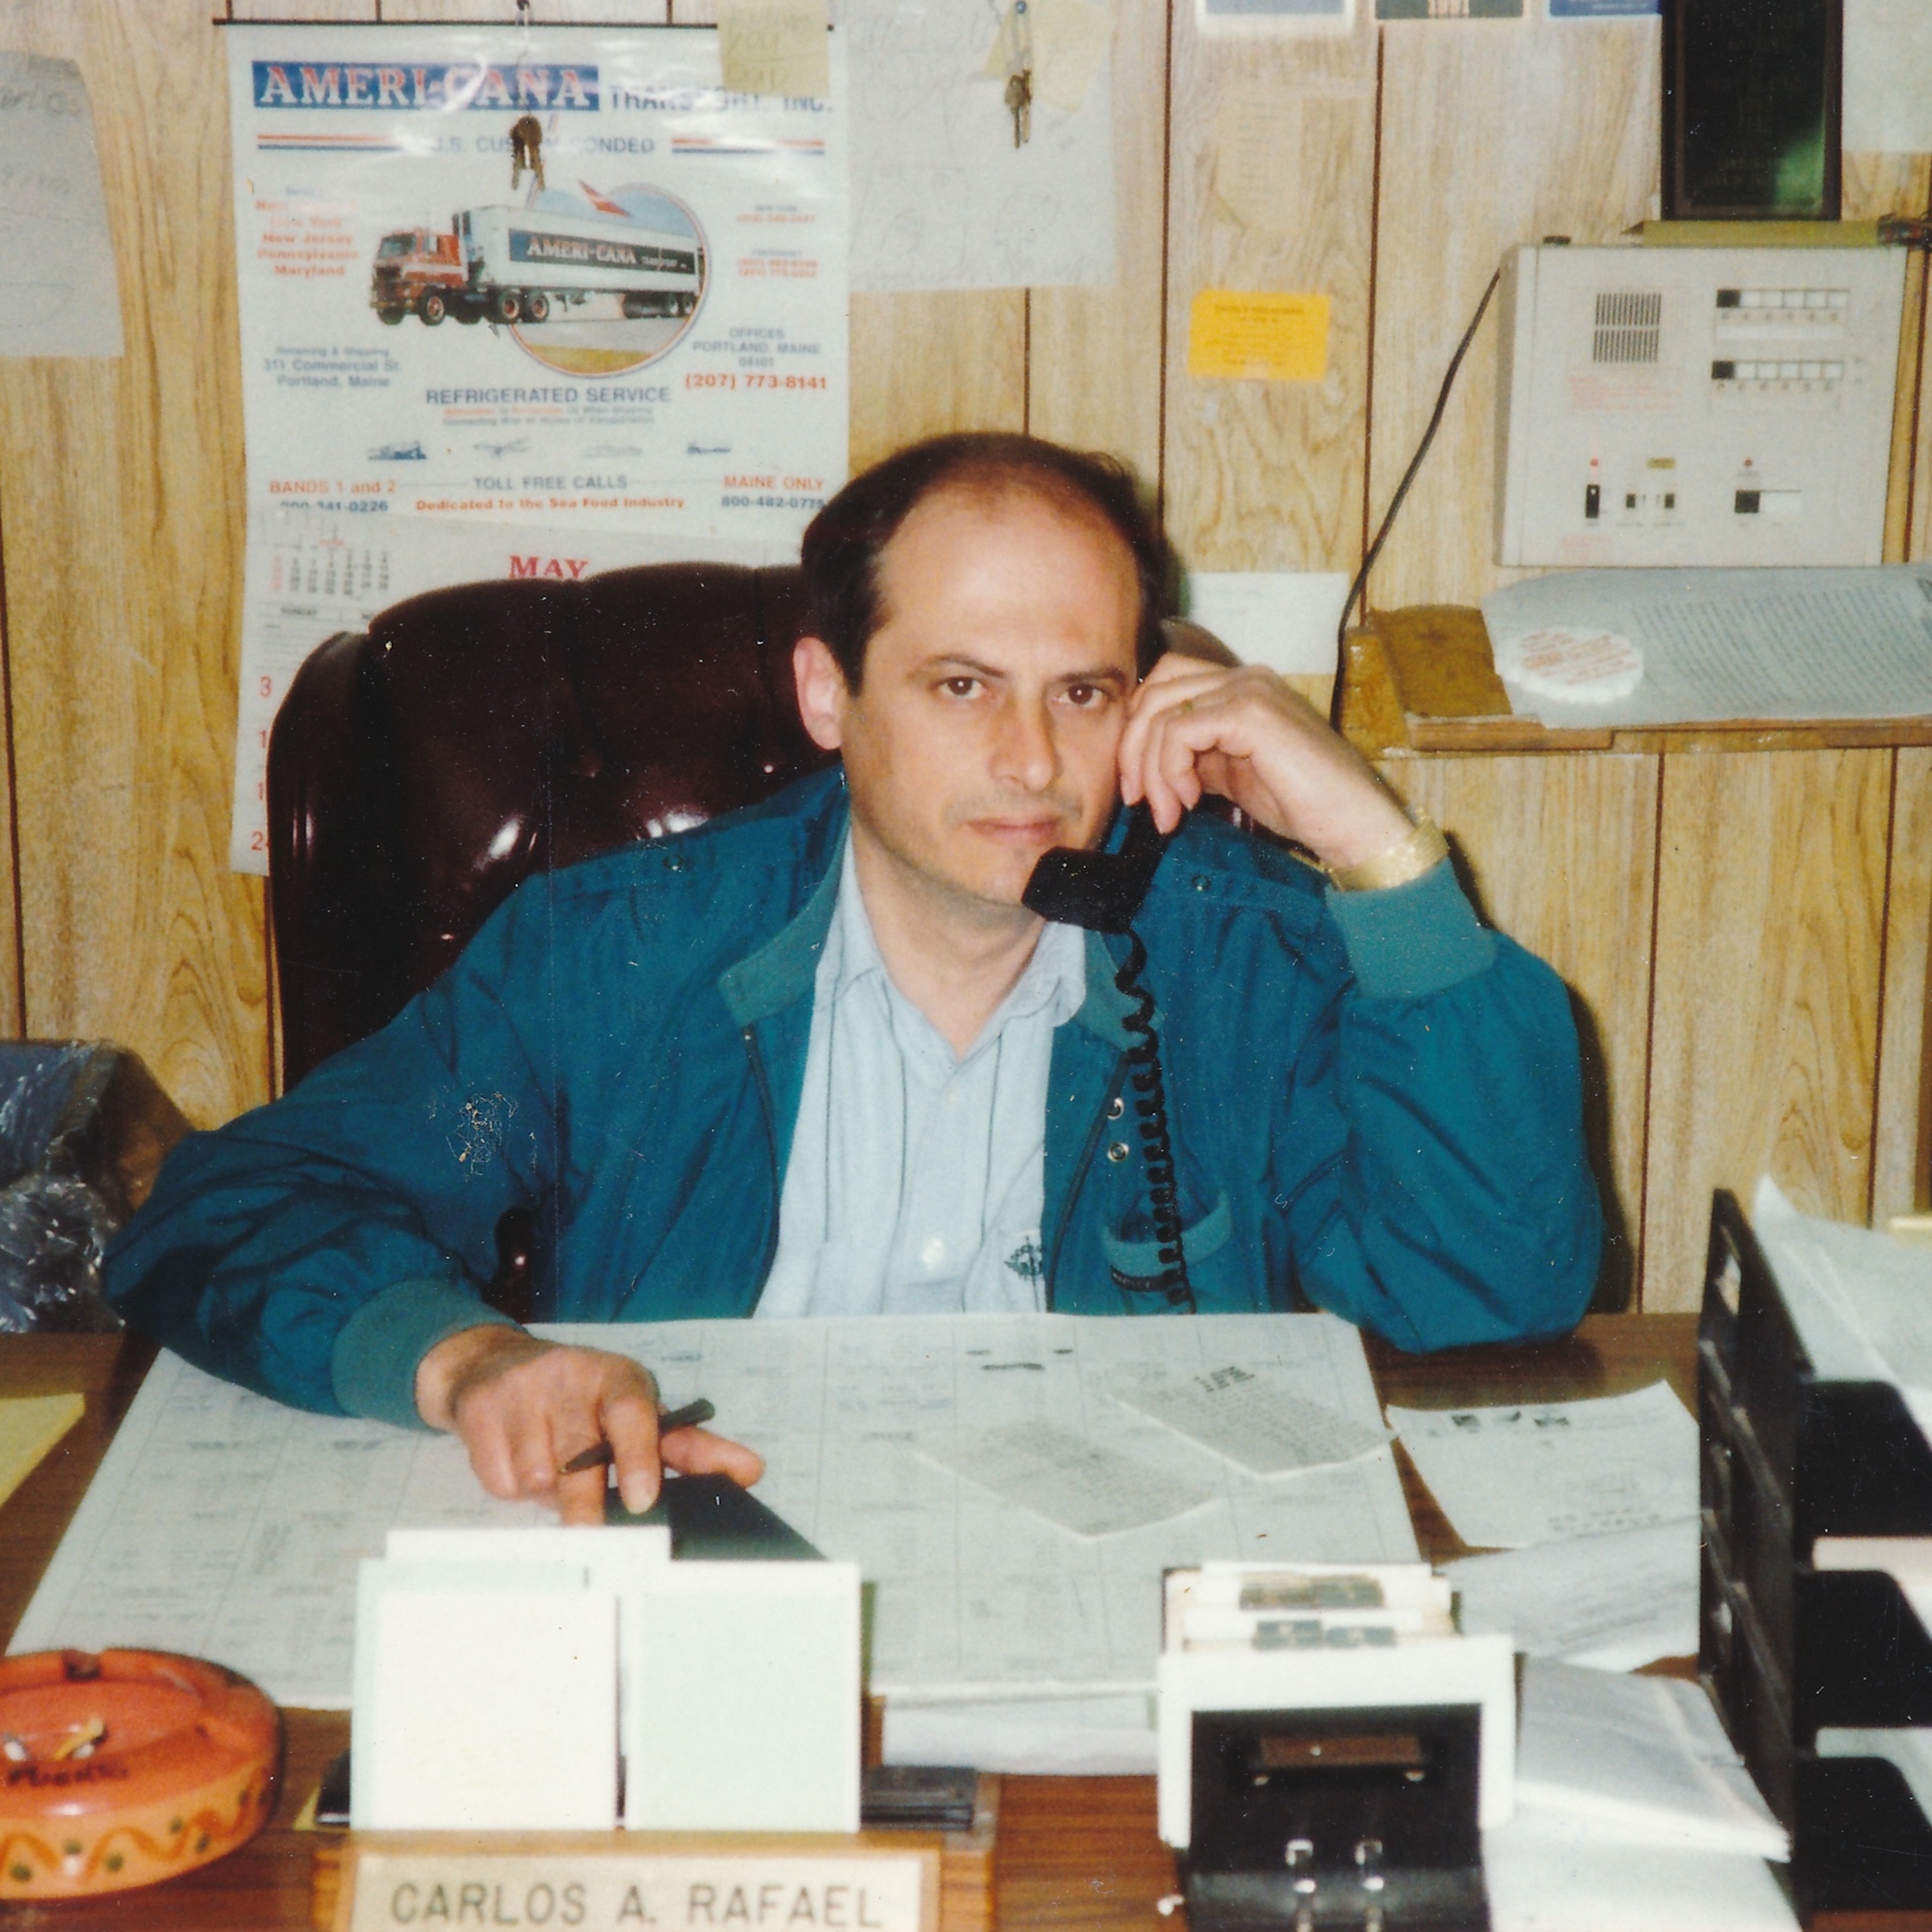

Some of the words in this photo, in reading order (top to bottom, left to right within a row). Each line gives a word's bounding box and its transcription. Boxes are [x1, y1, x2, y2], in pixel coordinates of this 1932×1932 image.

[274, 265, 345, 277] Maryland
[729, 328, 785, 339] OFFICES
[778, 343, 821, 354] MAINE
[292, 359, 378, 371] Commercial
[348, 375, 390, 387] Maine
[685, 373, 736, 390] (207)
[745, 374, 827, 389] 773-8141
[426, 388, 578, 404] REFRIGERATED
[586, 386, 671, 402] SERVICE
[270, 480, 328, 493] BANDS
[351, 480, 382, 493] and
[386, 480, 397, 493] 2
[473, 477, 513, 490] TOLL
[522, 476, 566, 489] FREE
[573, 475, 628, 489] CALLS
[723, 474, 775, 489] MAINE
[783, 476, 825, 489] ONLY
[416, 500, 493, 511] Dedicated
[499, 499, 513, 510] to
[519, 498, 542, 510] the
[549, 497, 578, 509] Sea
[582, 497, 618, 508] Food
[624, 497, 684, 509] Industry
[509, 554, 590, 578] MAY
[259, 675, 272, 698] 3
[391, 1883, 586, 1926] CARLOS
[617, 1884, 656, 1925] A.
[690, 1884, 883, 1927] RAFAEL
